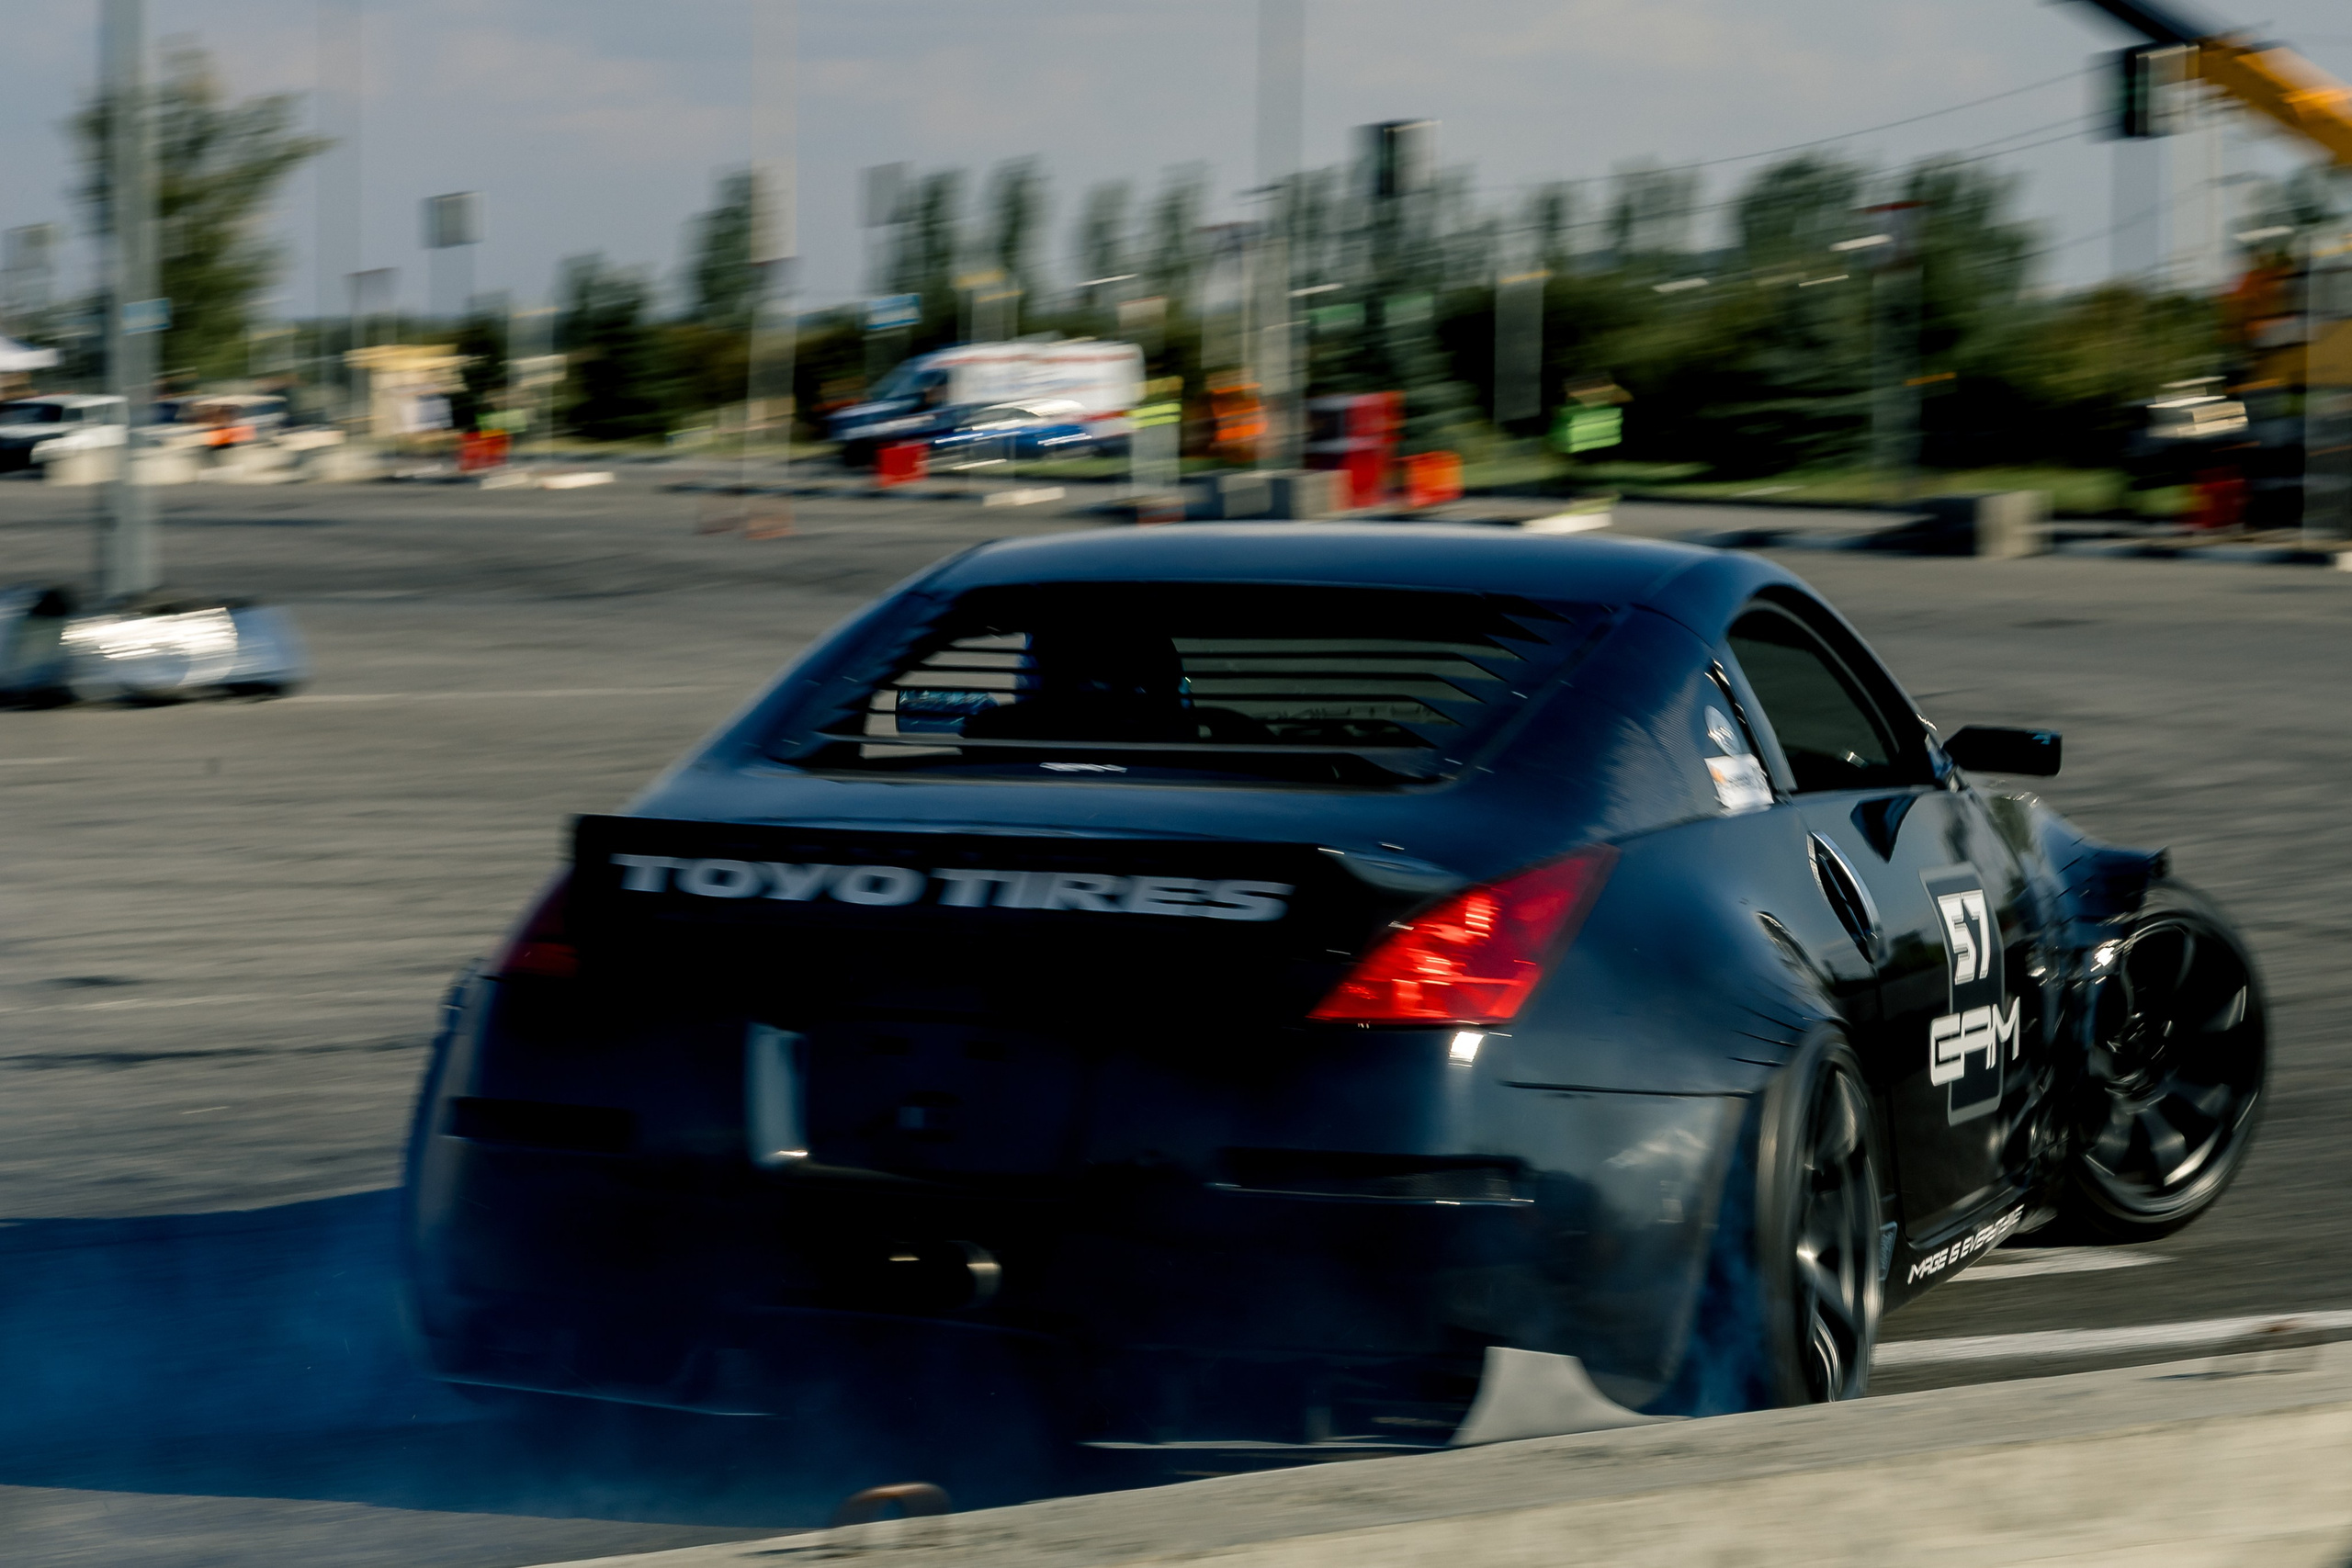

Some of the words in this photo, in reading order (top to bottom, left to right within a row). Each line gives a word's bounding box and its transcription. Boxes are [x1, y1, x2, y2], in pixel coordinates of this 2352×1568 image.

[610, 853, 923, 906] TOYO
[930, 867, 1294, 920] TIRES
[1937, 888, 1991, 986] 57
